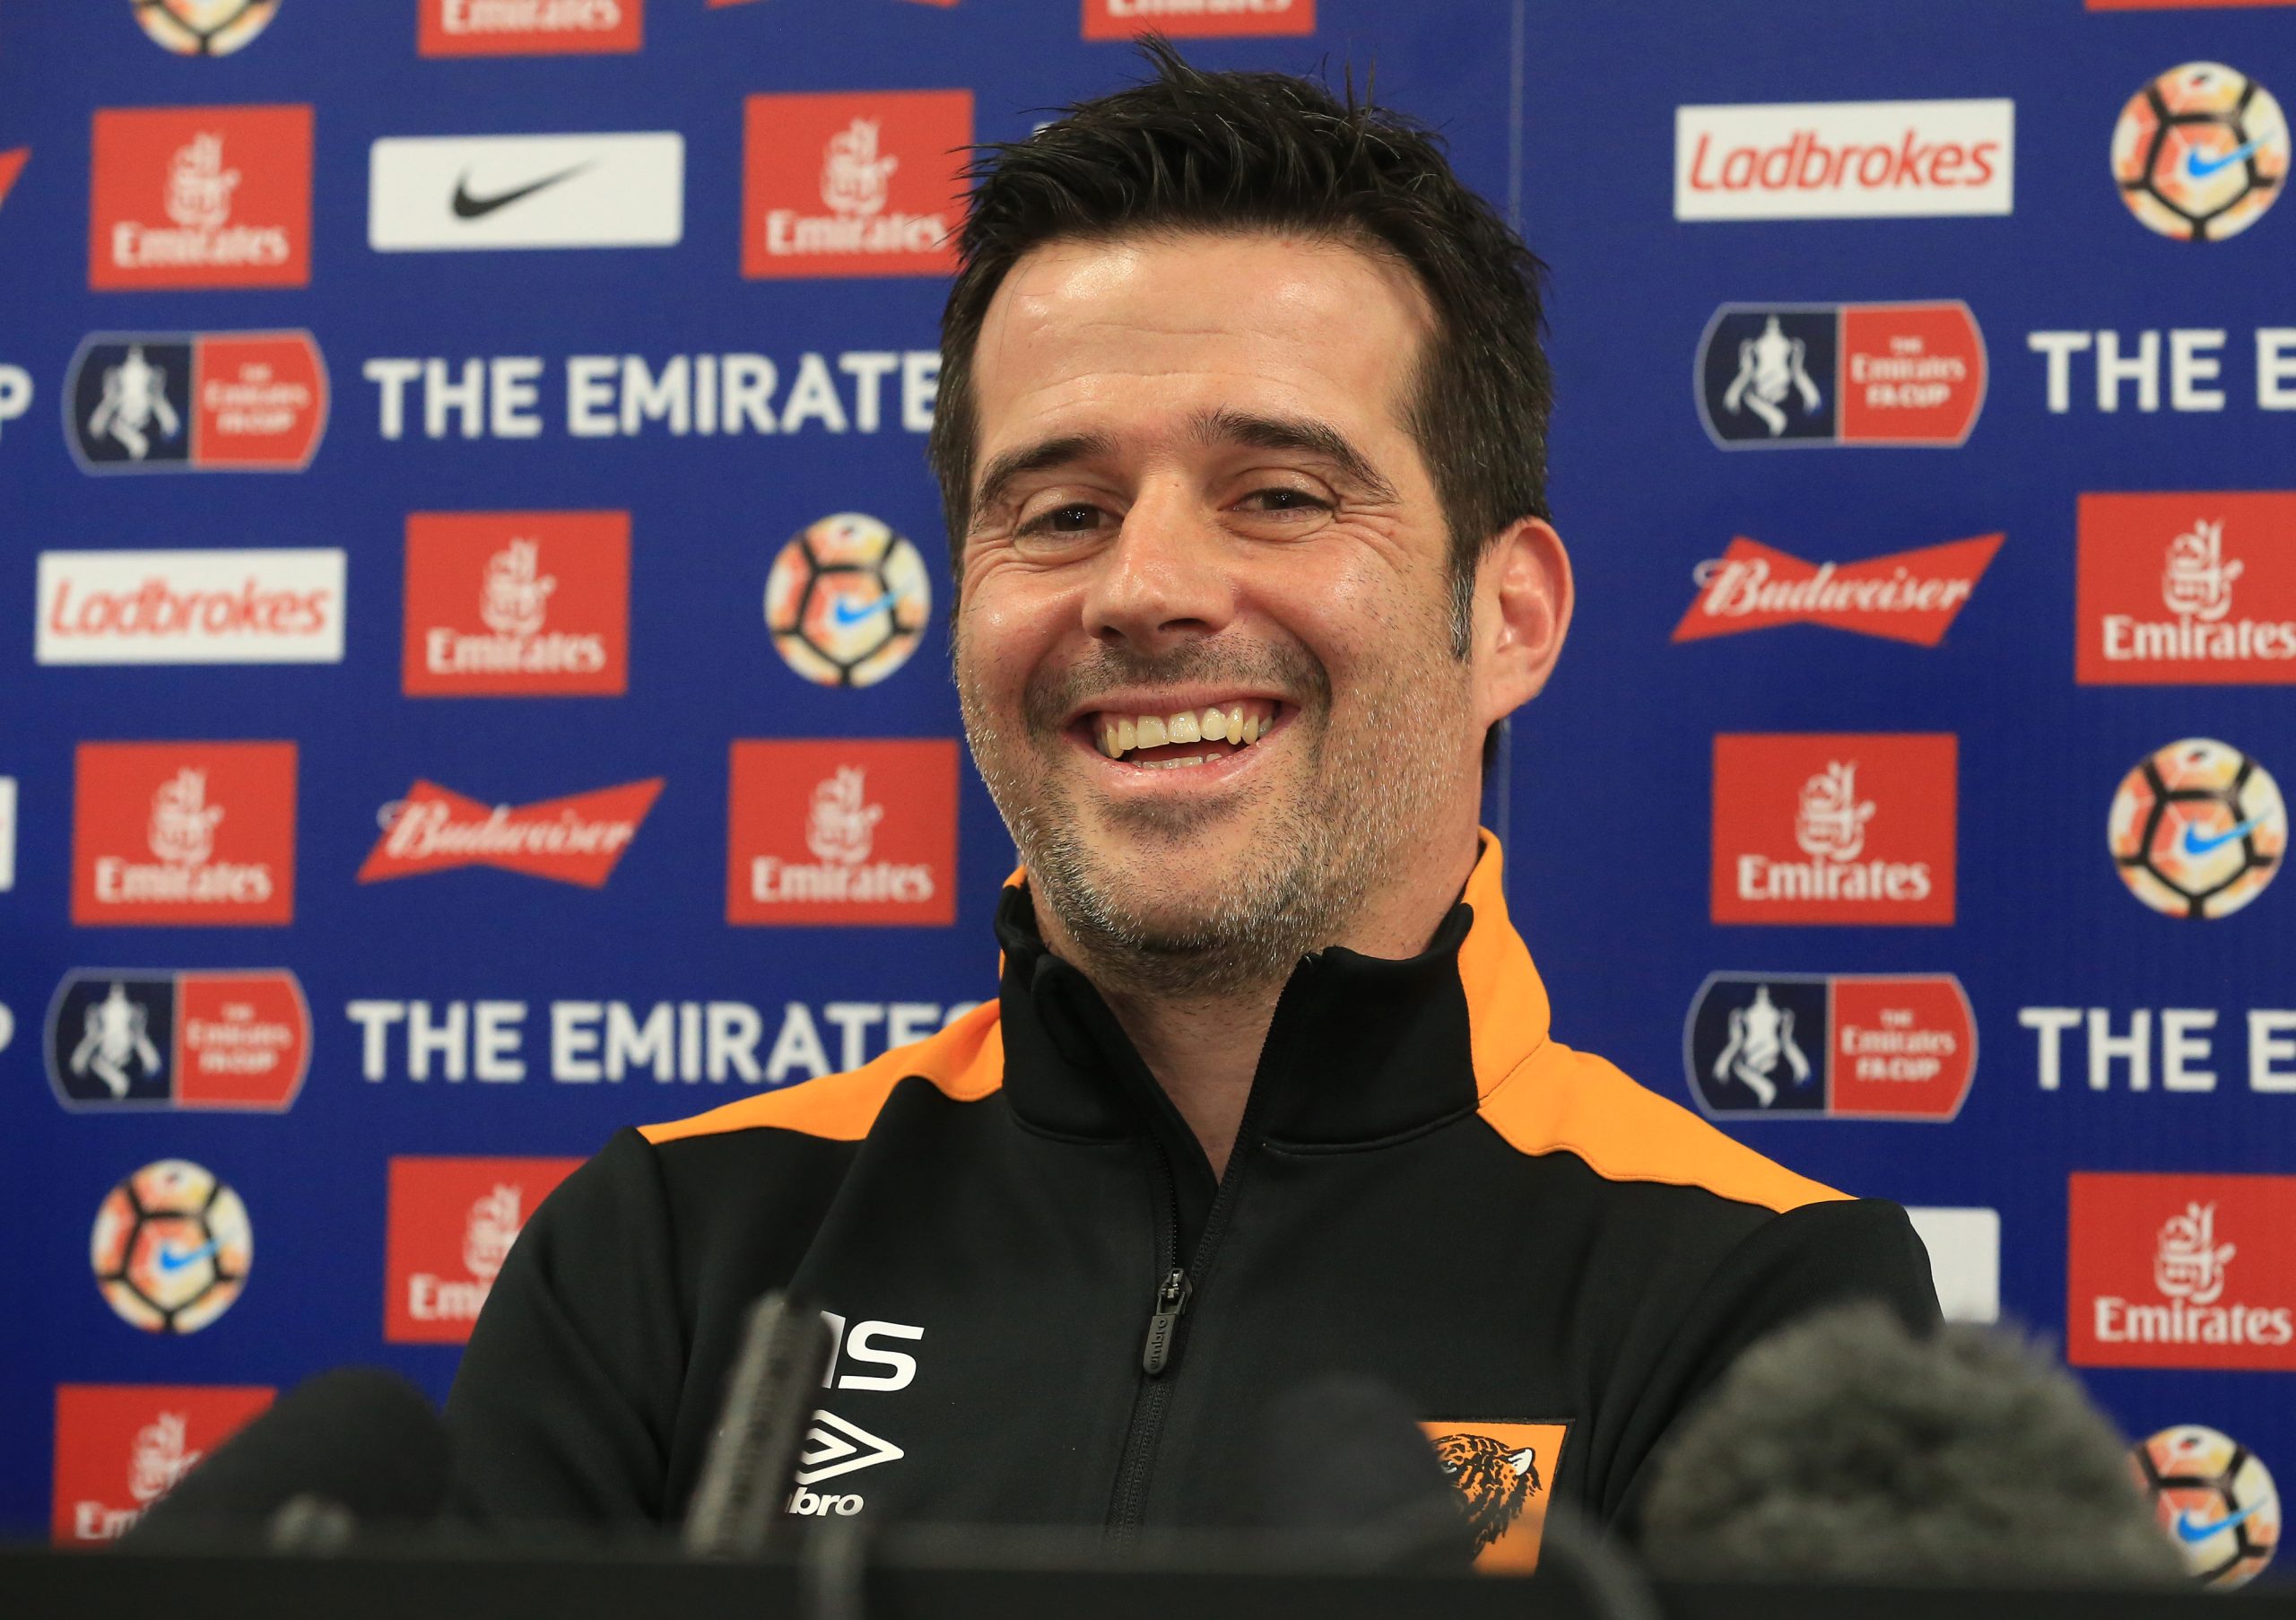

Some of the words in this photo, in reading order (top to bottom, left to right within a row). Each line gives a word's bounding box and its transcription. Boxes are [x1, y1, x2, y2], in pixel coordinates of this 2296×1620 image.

[1690, 128, 1998, 193] Ladbrokes
[111, 222, 290, 268] Emirates
[765, 210, 948, 256] Emirates
[2027, 328, 2226, 414] THE
[363, 357, 543, 440] THE
[49, 578, 330, 638] Ladbrokes
[1693, 557, 1971, 617] Budweiser
[426, 627, 606, 675] Emirates
[2102, 614, 2296, 660] Emirates
[377, 799, 634, 859] Budweiser
[94, 856, 273, 903] Emirates
[751, 855, 935, 902] Emirates
[1737, 854, 1931, 901] Emirates
[346, 1000, 526, 1083] THE
[551, 1000, 983, 1084] EMIRATE
[1841, 1025, 1956, 1056] Emirates
[2018, 1007, 2217, 1092] THE
[1150, 1319, 1168, 1370] umbro
[2094, 1295, 2293, 1345] Emirates
[786, 1486, 864, 1517] bro
